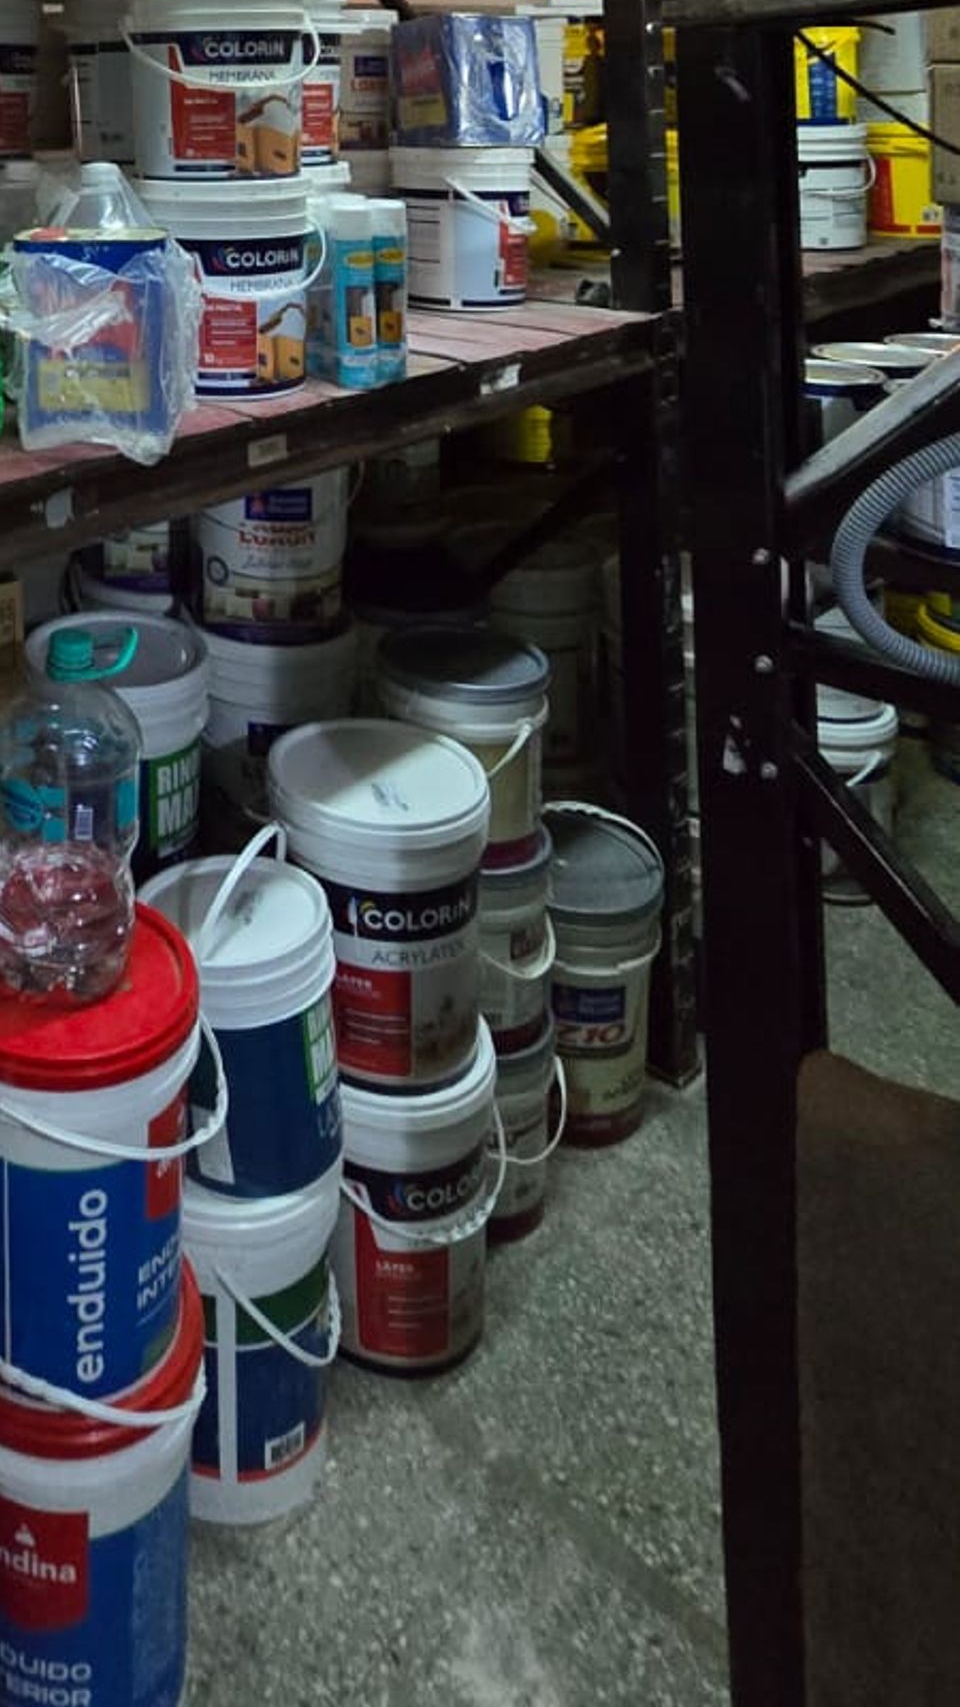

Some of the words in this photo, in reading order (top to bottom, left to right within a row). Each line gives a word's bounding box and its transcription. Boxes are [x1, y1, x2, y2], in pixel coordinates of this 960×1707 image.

[205, 40, 285, 58] COLORIN
[226, 250, 300, 269] COLORIN
[363, 897, 471, 931] COLORIN
[407, 1175, 472, 1211] COLO
[67, 1189, 108, 1382] enduido
